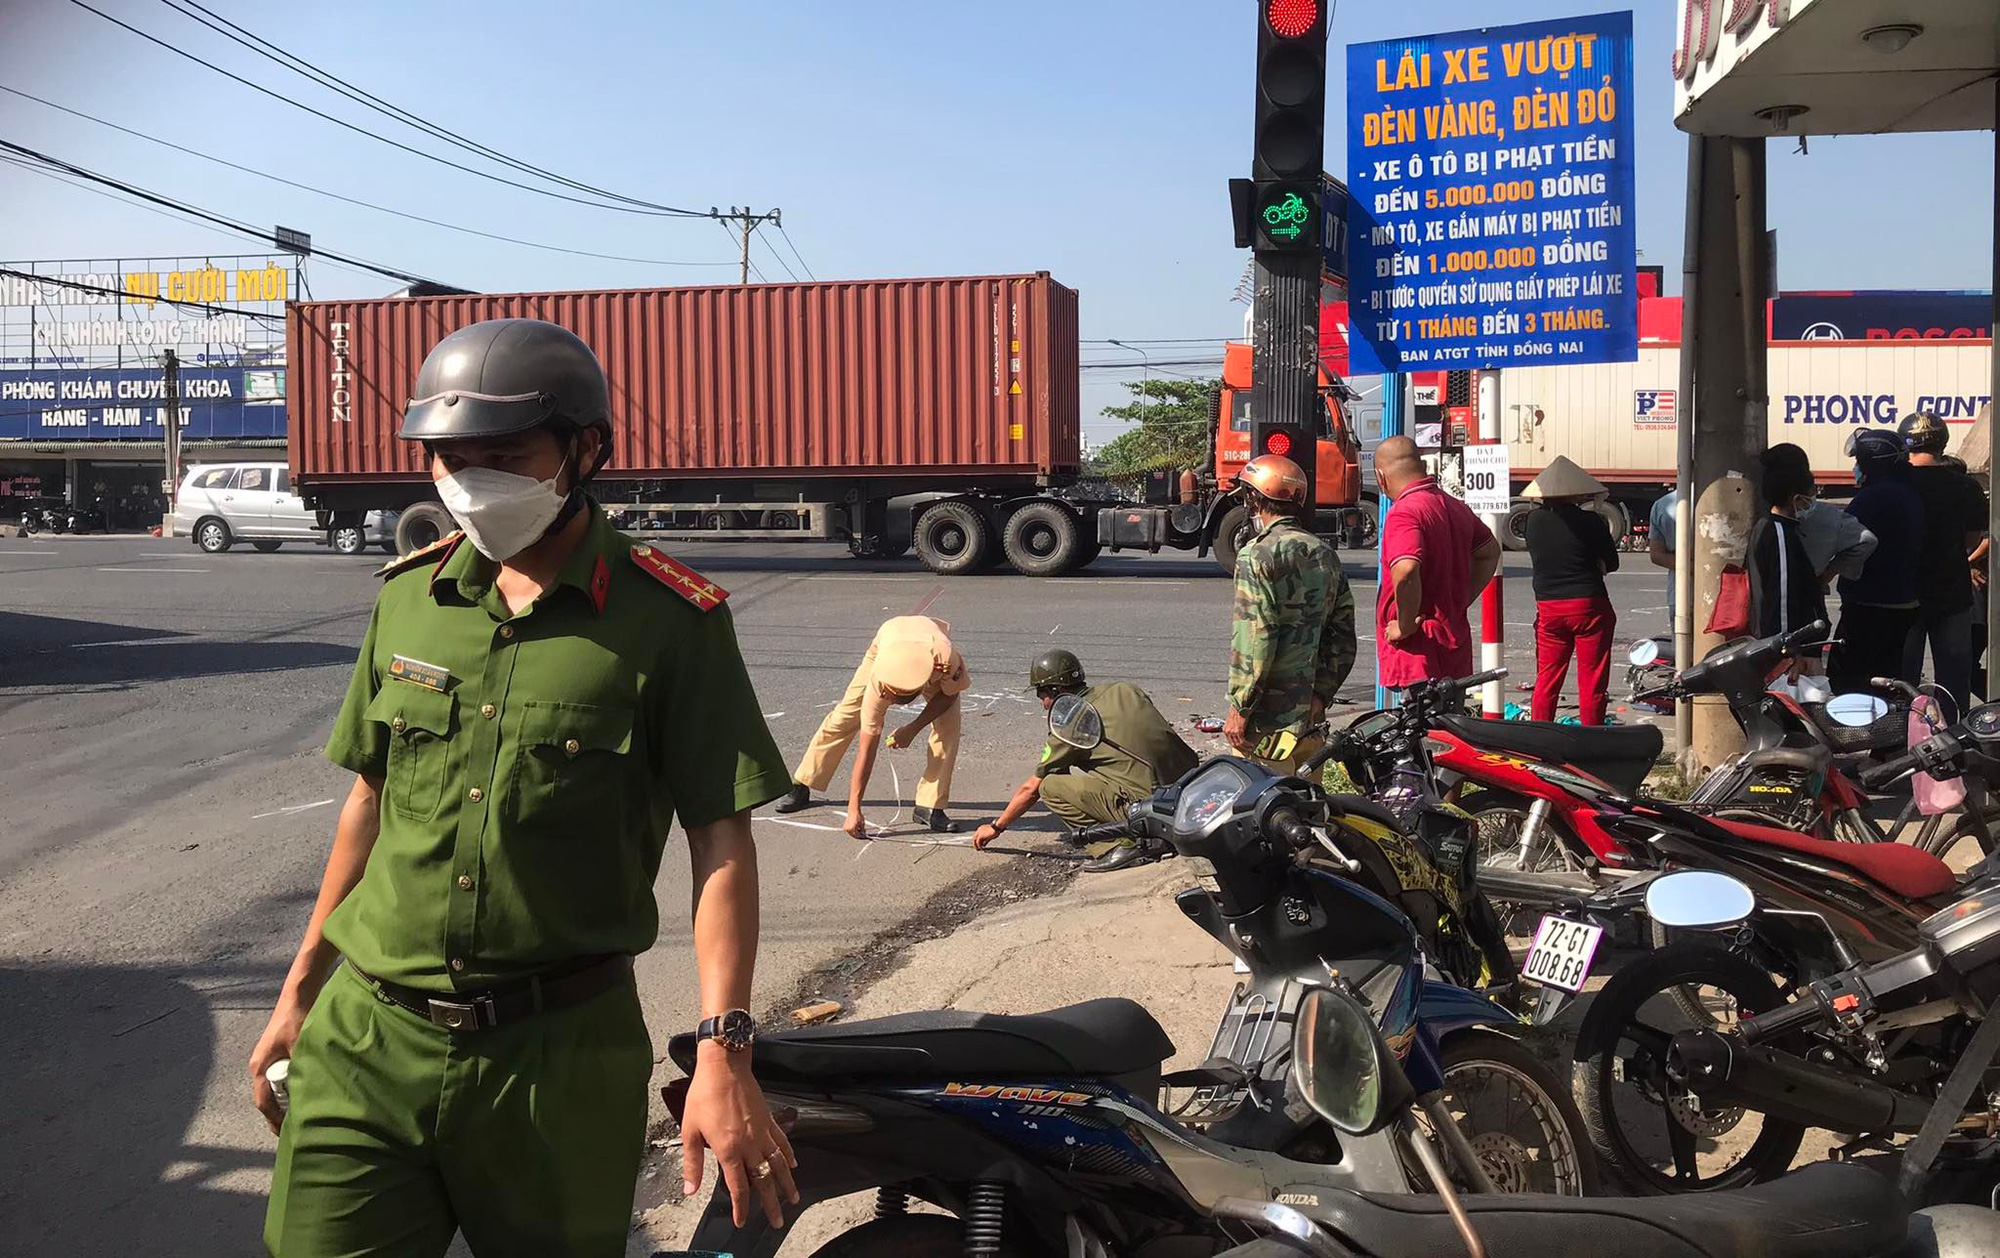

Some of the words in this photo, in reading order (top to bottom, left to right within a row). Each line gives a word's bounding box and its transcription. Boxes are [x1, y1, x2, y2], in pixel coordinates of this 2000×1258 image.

[1376, 49, 1431, 92] LÁI
[1443, 46, 1489, 85] XE
[1502, 32, 1597, 80] VƯỢT
[1363, 104, 1416, 147] ĐÈN
[1424, 97, 1505, 141] VÀNG,
[1513, 87, 1569, 131] ĐÈN
[1577, 75, 1617, 124] ĐỎ
[1373, 160, 1401, 182] XE
[1408, 153, 1424, 178] Ô
[1430, 150, 1458, 176] TÔ
[1465, 151, 1488, 176] BỊ
[1495, 144, 1555, 172] PHẠT
[1562, 133, 1616, 164] TIỀN
[1374, 185, 1418, 214] ĐẾN
[1425, 180, 1535, 209] 5.000.000
[1541, 169, 1606, 199] ĐỒNG
[1371, 220, 1394, 246] MÔ
[1399, 219, 1422, 246] TÔ,
[1425, 220, 1444, 242] XE
[1448, 211, 1480, 239] GẮN
[1483, 210, 1517, 237] MÁY
[1521, 211, 1538, 237] BỊ
[1542, 210, 1582, 235] PHẠT
[1586, 200, 1622, 228] TIỀN
[1375, 248, 1420, 278] ĐẾN
[1427, 246, 1536, 274] 1.000.000
[1542, 237, 1608, 266] ĐỒNG
[125, 272, 160, 310] NỤ
[167, 263, 227, 304] CƯỜI
[236, 261, 288, 301] MỚI
[1371, 289, 1383, 314] BỊ
[1385, 281, 1415, 309] TƯỚC
[1418, 278, 1457, 307] QUYỀN
[1460, 277, 1477, 304] SỬ
[1479, 280, 1513, 307] DỤNG
[1516, 271, 1545, 300] GIẤY
[1547, 273, 1580, 299] PHÉP
[1583, 271, 1603, 297] LÁI
[1606, 274, 1623, 295] XE
[34, 321, 63, 345] CHI
[67, 312, 126, 345] NHÁNH
[131, 319, 181, 344] LONG
[1376, 317, 1400, 342] TỪ
[1403, 322, 1411, 340] 1
[1418, 312, 1477, 340] THÁNG
[1482, 308, 1520, 336] ĐẾN
[1525, 312, 1537, 333] 3
[1541, 305, 1611, 332] THÁNG.
[1401, 350, 1429, 362] BAN
[1434, 347, 1470, 361] ATGT
[1475, 343, 1508, 359] TỈNH
[1513, 341, 1553, 356] ĐỒNG
[1559, 341, 1584, 354] NAI
[2, 377, 56, 400] PHÒNG
[61, 376, 113, 399] KHÁM
[185, 379, 232, 398] KHOA
[331, 322, 351, 422] TRITON
[41, 404, 87, 427] RĂNG
[103, 404, 141, 427] HÀM
[1784, 394, 1898, 423] PHONG
[1466, 472, 1494, 490] 300
[1527, 948, 1585, 986] 008.68
[1017, 1104, 1066, 1117] 110
